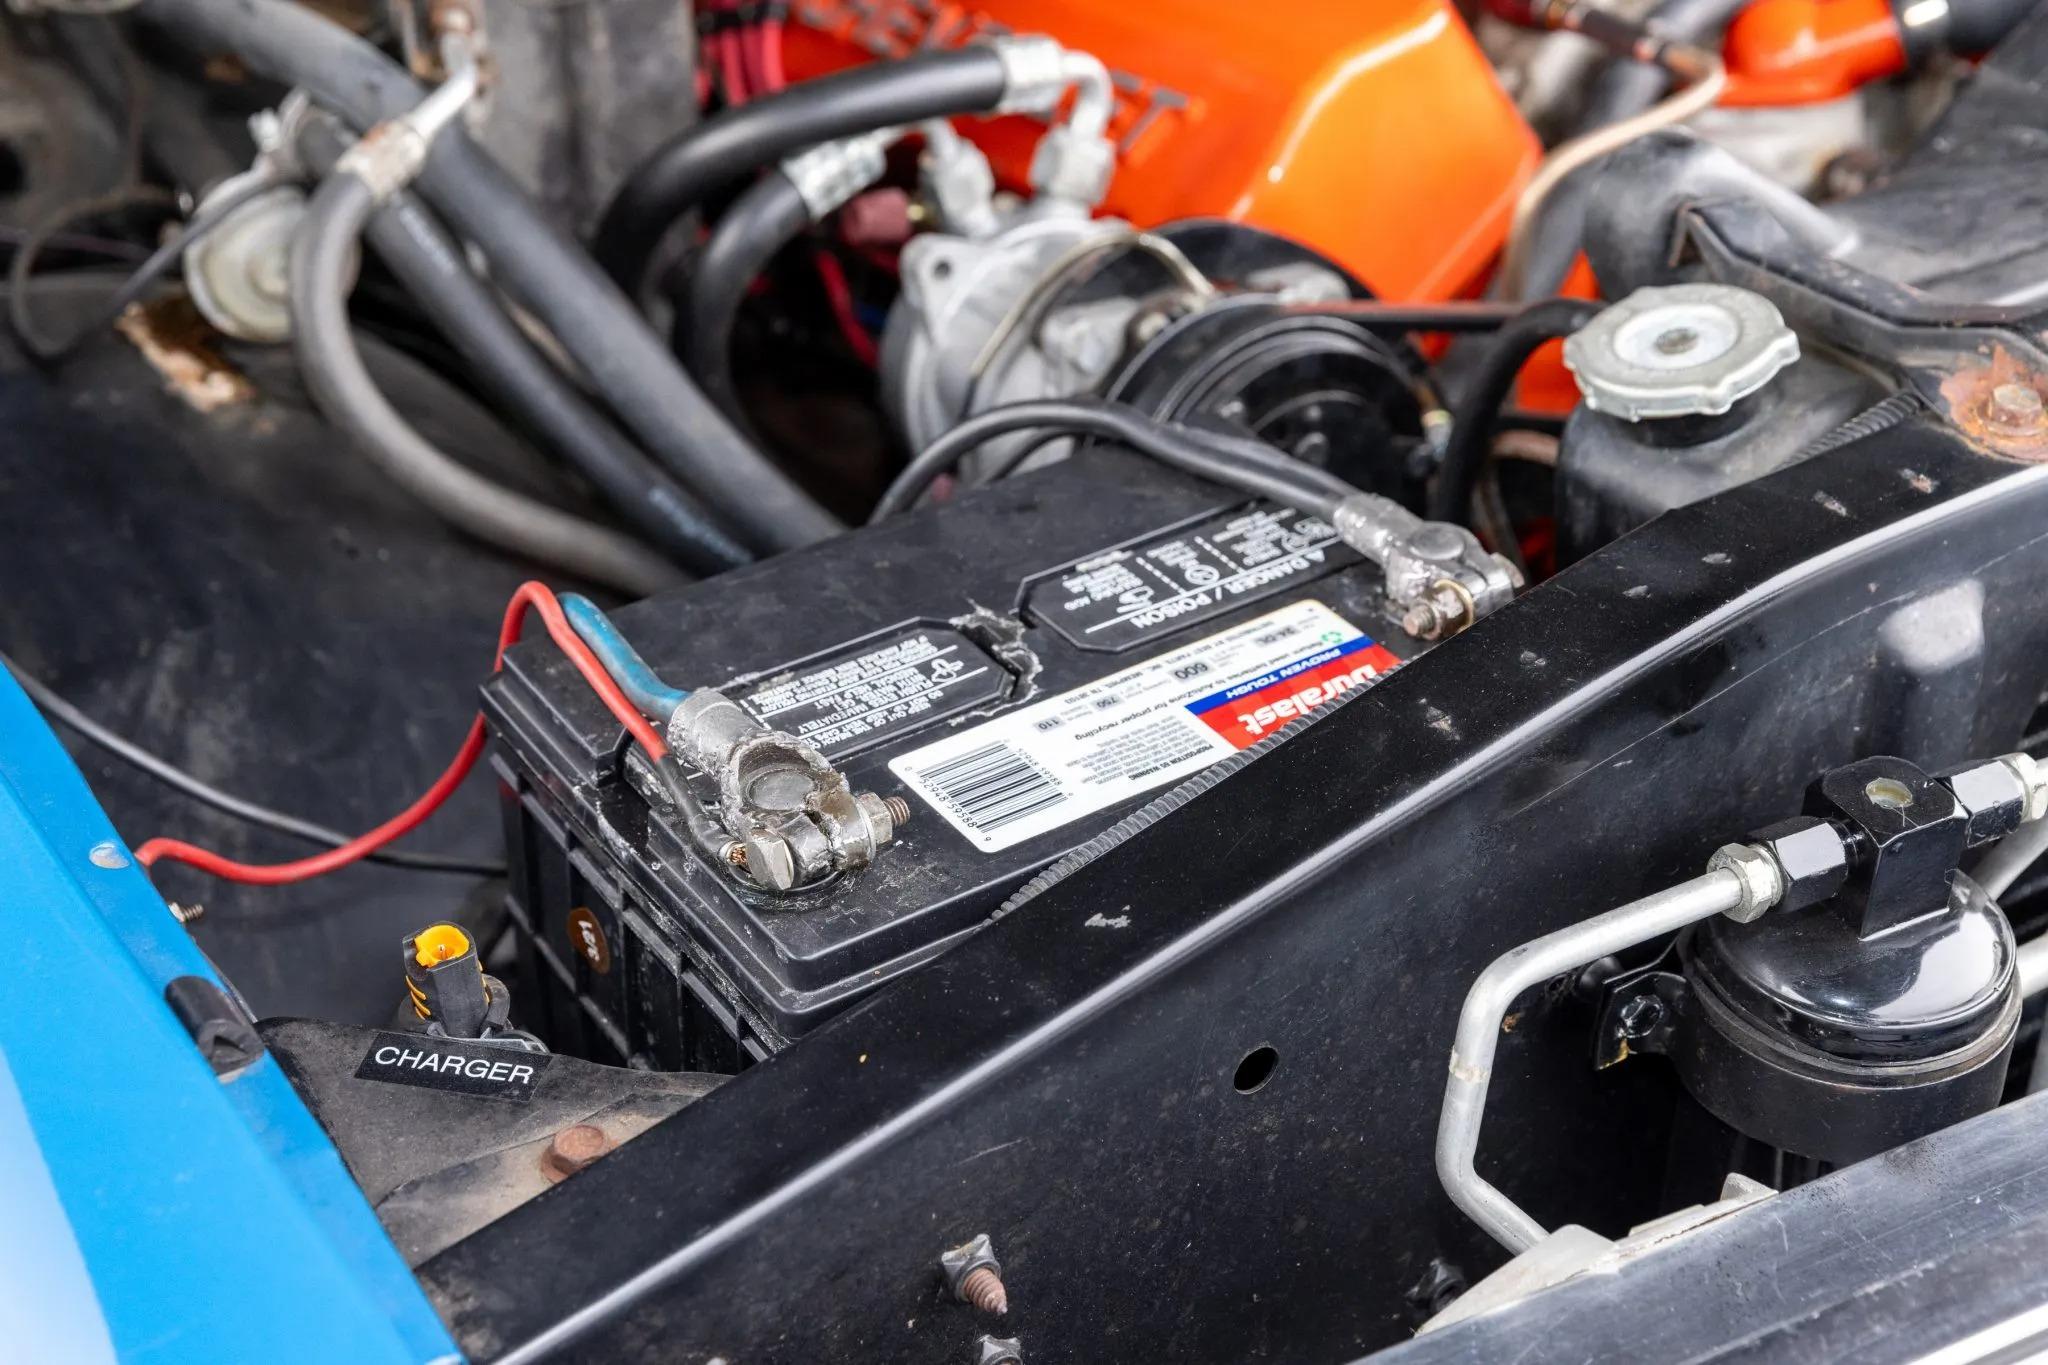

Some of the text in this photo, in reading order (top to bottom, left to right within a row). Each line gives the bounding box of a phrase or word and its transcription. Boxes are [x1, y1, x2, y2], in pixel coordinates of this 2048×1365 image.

[1224, 558, 1310, 594] DANGER
[1130, 593, 1210, 629] POISON
[1173, 662, 1208, 679] 600
[1279, 647, 1341, 677] PROVEN
[1168, 682, 1213, 703] AutoZone
[1225, 671, 1278, 698] TOUGH
[813, 693, 842, 709] FAST
[832, 697, 856, 711] GET
[867, 692, 898, 707] EYES
[1096, 696, 1117, 708] 750
[1153, 701, 1168, 710] for
[798, 703, 868, 733] IMMEDIATELY
[1037, 718, 1059, 730] 110
[1120, 706, 1151, 723] proper
[1074, 721, 1118, 740] recycling
[919, 776, 949, 802] 52948
[947, 801, 977, 828] 59588
[375, 1046, 535, 1085] CHARGER
